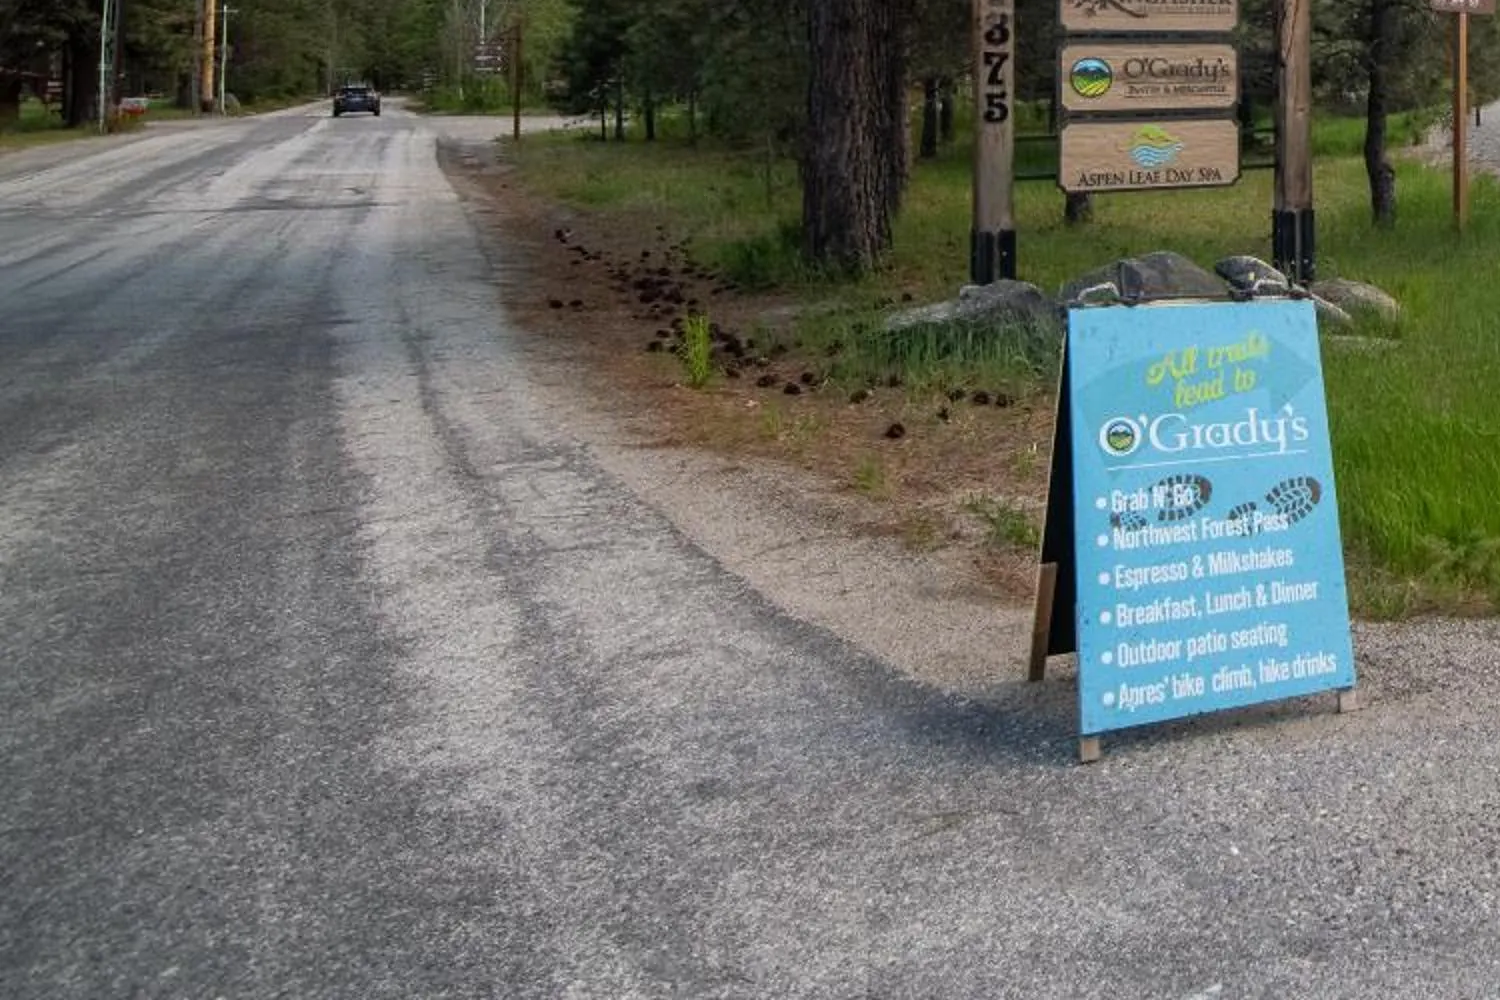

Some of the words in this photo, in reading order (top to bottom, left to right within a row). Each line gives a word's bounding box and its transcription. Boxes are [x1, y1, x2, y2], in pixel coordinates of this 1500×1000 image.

[1123, 57, 1230, 83] O'Grady's
[1078, 171, 1125, 187] ASPEN
[1129, 169, 1161, 185] LEAF
[1165, 168, 1194, 184] DAY
[1199, 167, 1223, 182] SPA
[1146, 346, 1198, 385] All
[1174, 370, 1226, 408] lead
[1234, 367, 1257, 393] to
[1099, 402, 1309, 456] O'Grady's
[1111, 488, 1148, 513] Grab
[1173, 483, 1194, 506] Go
[1113, 521, 1198, 550] Northwest
[1201, 515, 1249, 540] Forest
[1253, 510, 1290, 532] Pass
[1114, 561, 1188, 591] Espresso
[1191, 554, 1205, 579] &
[1208, 545, 1294, 577] Milkshakes
[1116, 596, 1203, 628] Breakfast,
[1206, 585, 1252, 615] Lunch
[1255, 583, 1267, 609] &
[1271, 580, 1320, 605] Dinner
[1117, 638, 1183, 668] Outdoor
[1186, 629, 1227, 661] patio
[1231, 620, 1289, 648] seating
[1172, 671, 1204, 699] bike
[1212, 664, 1257, 692] climb,
[1259, 657, 1290, 685] hike
[1293, 650, 1338, 679] drinks
